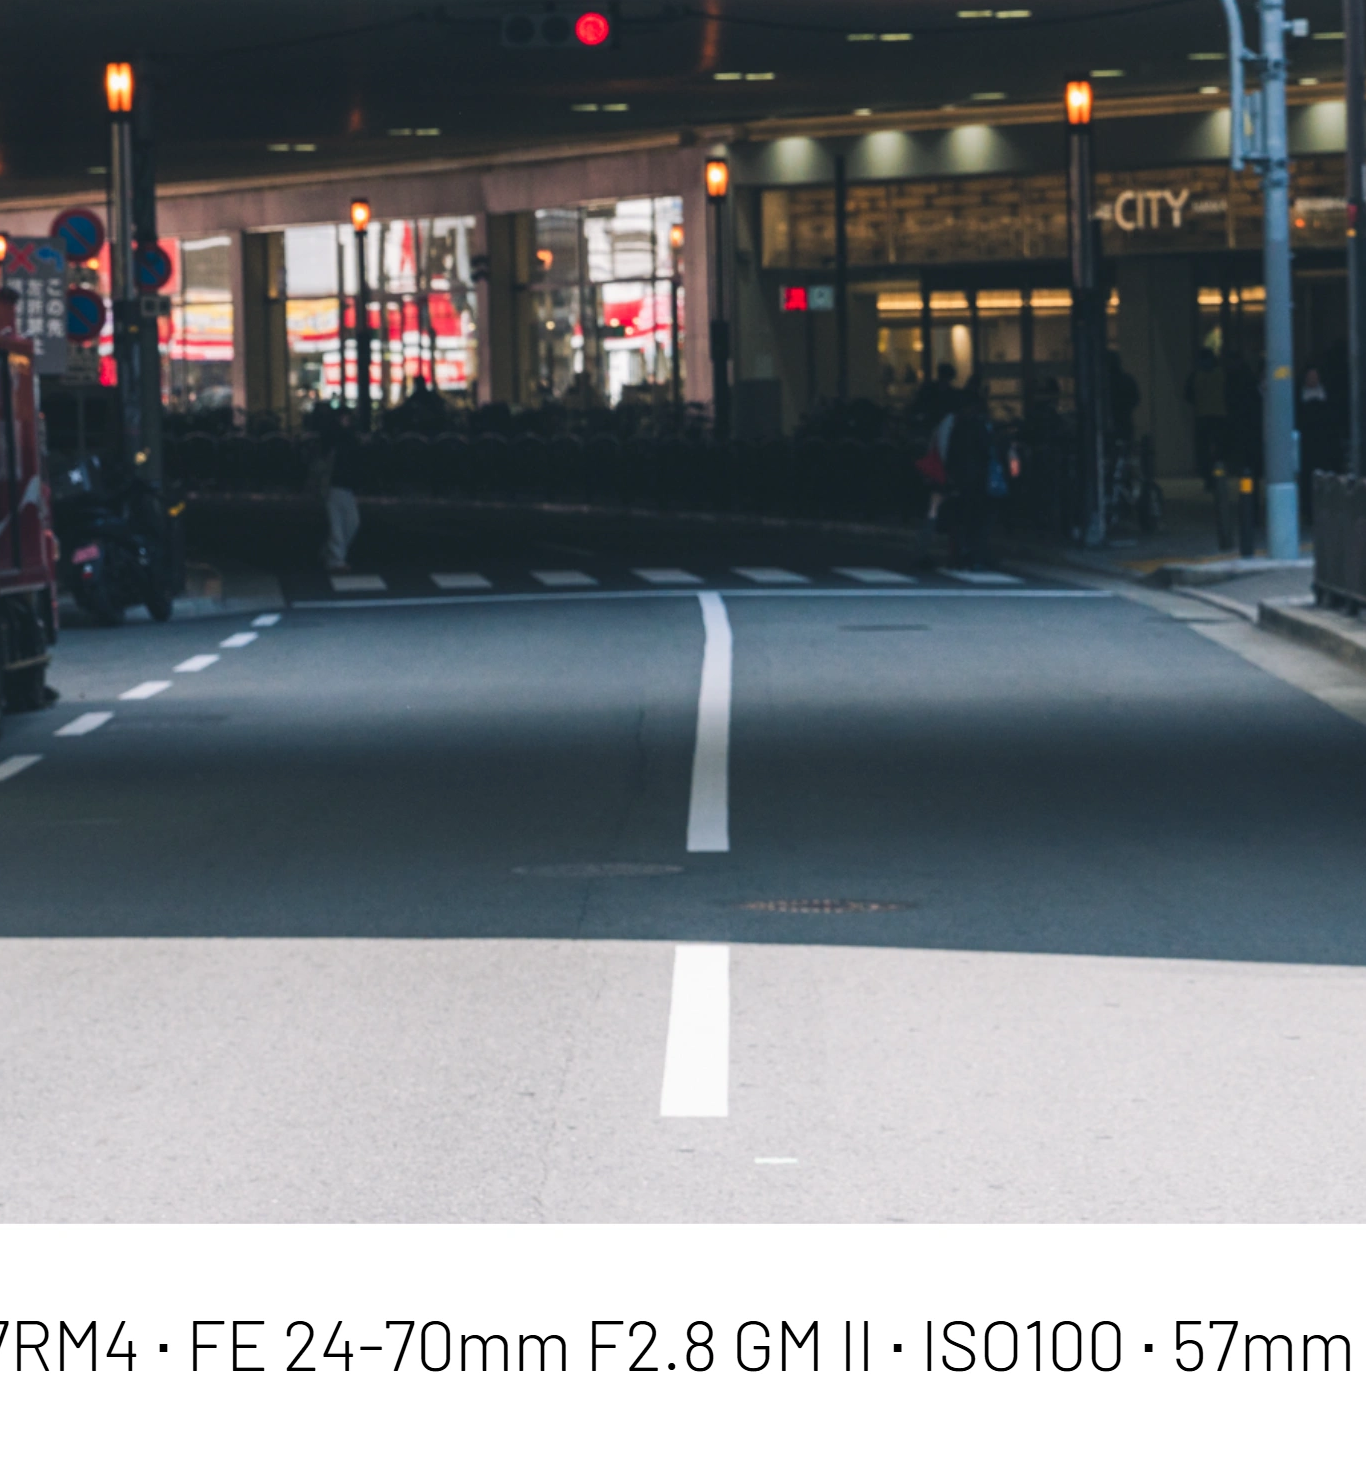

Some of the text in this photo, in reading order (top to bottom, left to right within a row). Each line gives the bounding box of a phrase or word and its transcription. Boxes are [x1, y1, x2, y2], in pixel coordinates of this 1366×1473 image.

[1114, 188, 1190, 230] CITY
[46, 277, 66, 338] この先
